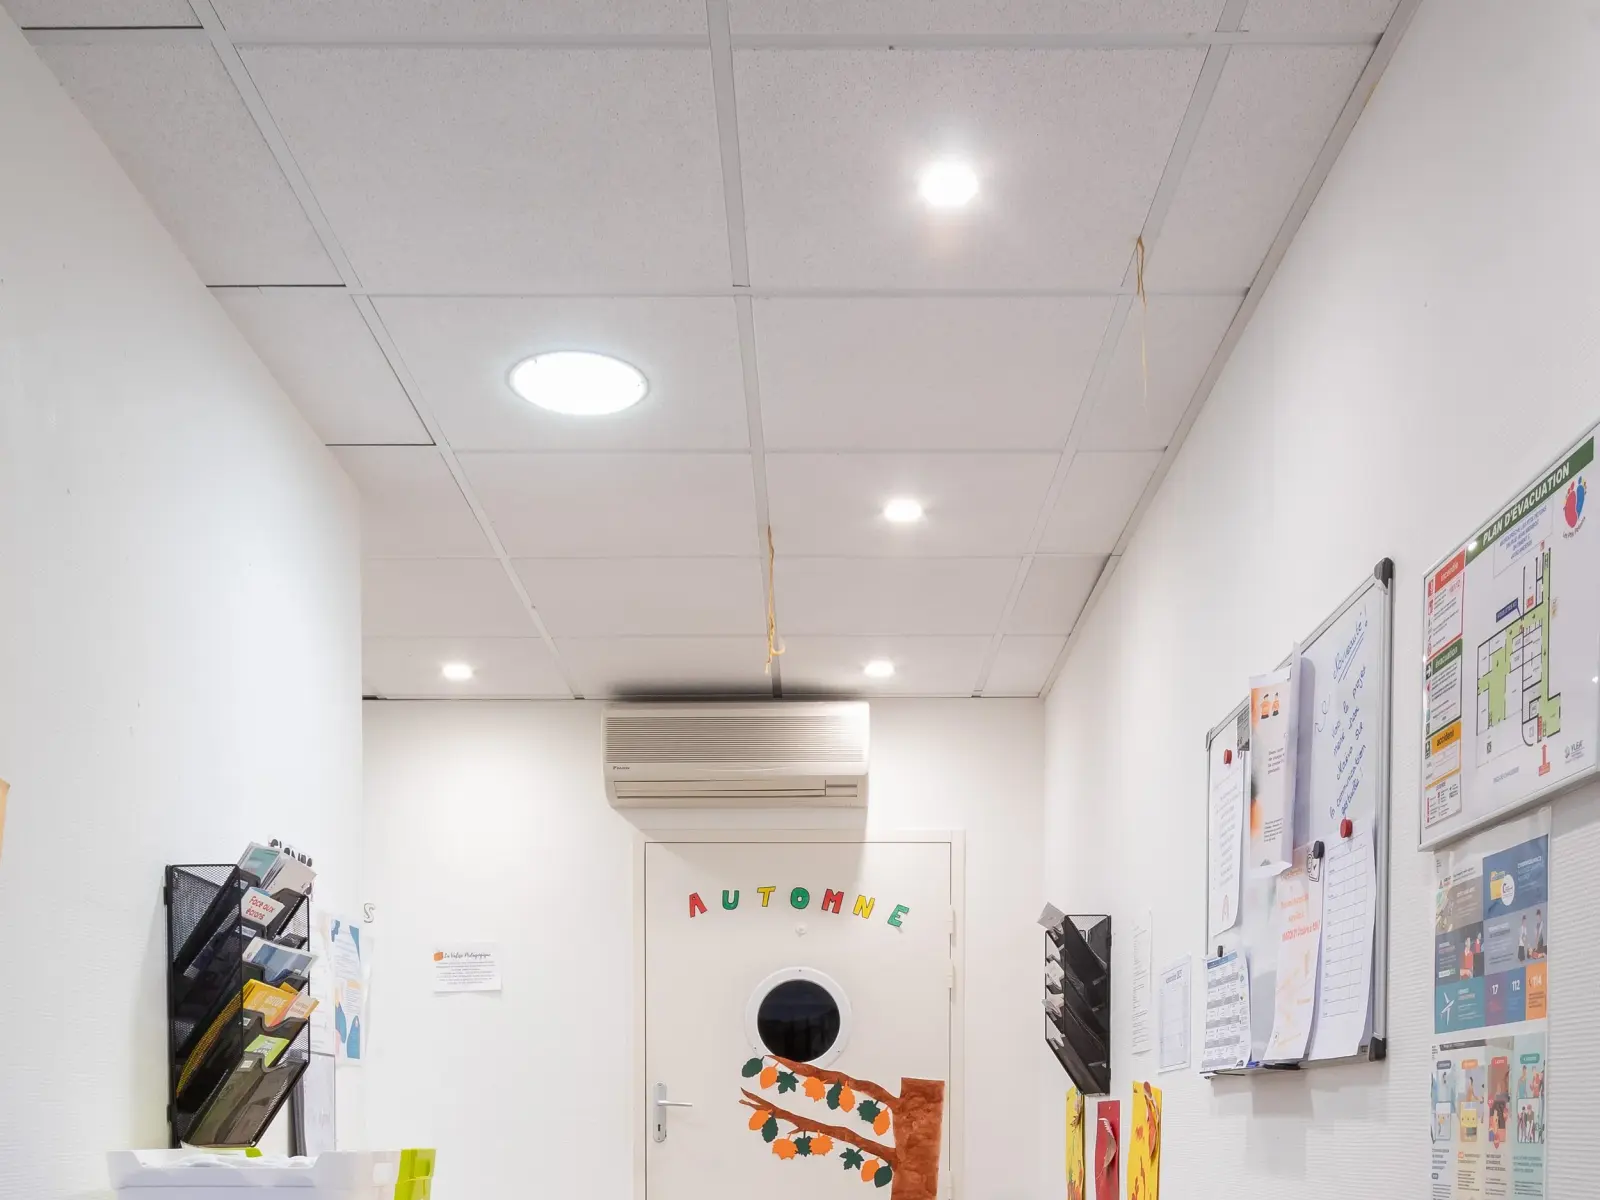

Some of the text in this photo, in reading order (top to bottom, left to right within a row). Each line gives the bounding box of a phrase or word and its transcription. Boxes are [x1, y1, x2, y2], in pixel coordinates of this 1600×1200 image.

[1483, 519, 1503, 546] PLAN
[689, 885, 910, 928] AUTOMNE
[1492, 984, 1498, 995] 17
[1512, 979, 1520, 991] 112
